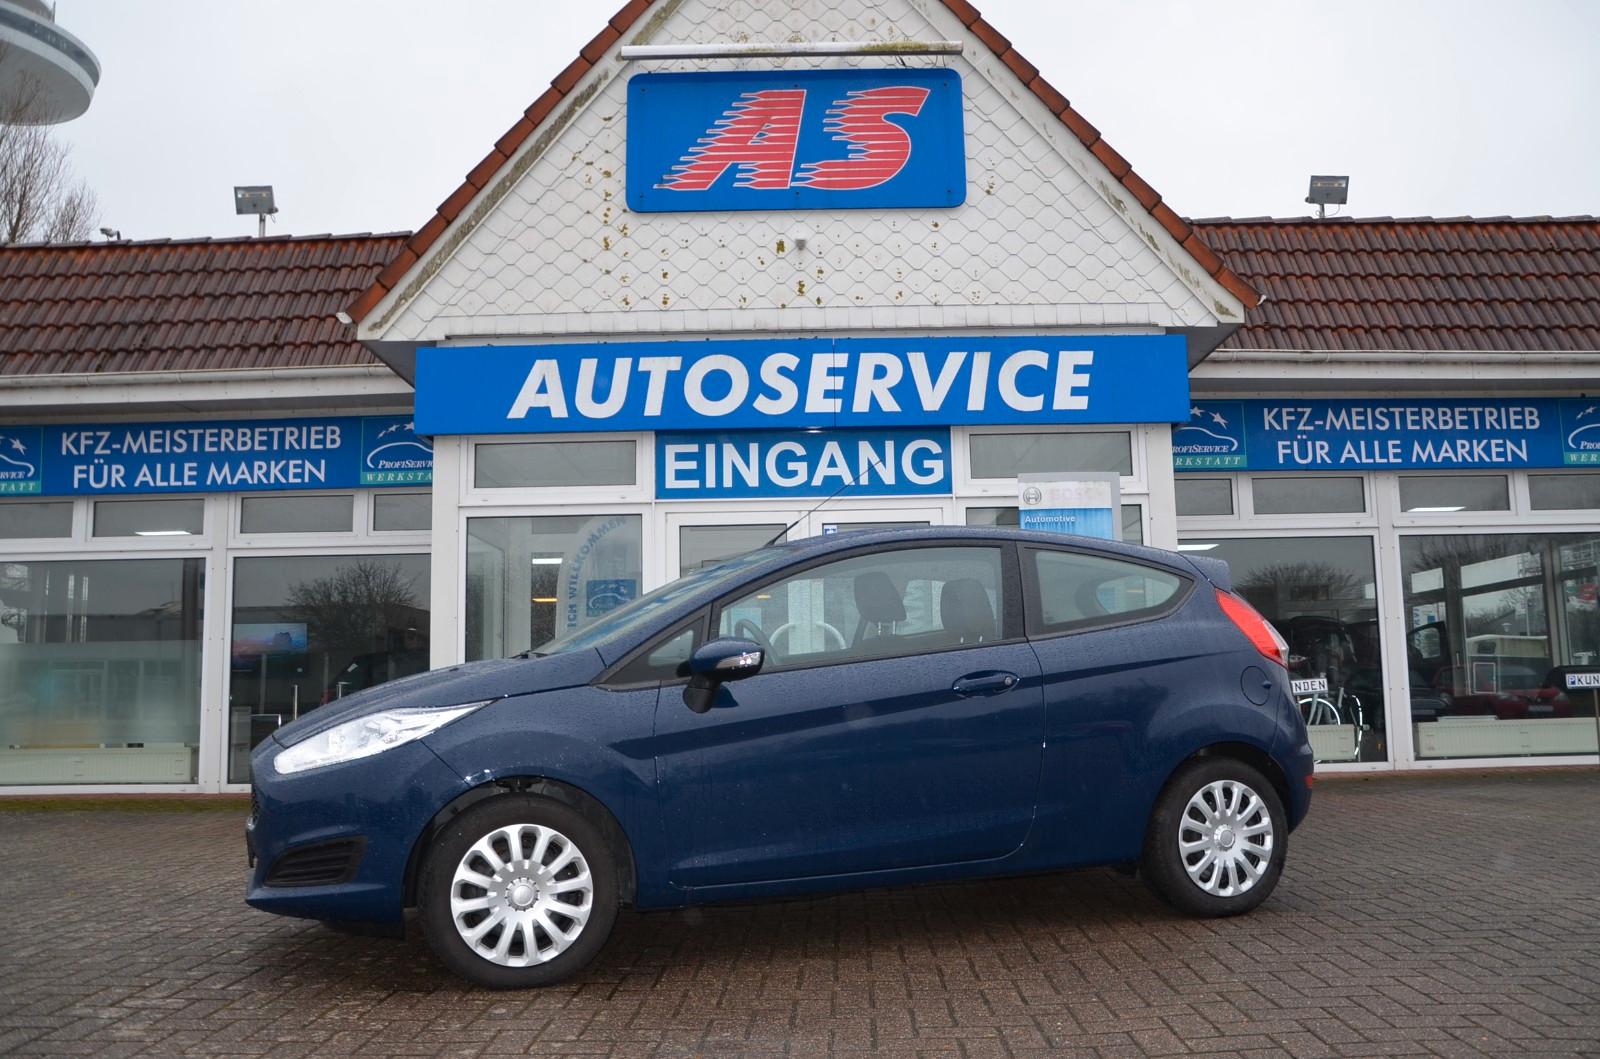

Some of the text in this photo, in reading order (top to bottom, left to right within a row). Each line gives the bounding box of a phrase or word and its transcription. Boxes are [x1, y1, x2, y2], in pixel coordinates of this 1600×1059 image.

[653, 86, 931, 191] AS
[507, 349, 1094, 421] AUTOSERVICE
[1263, 406, 1541, 431] KFZ-MEISTERBETRIEB
[61, 425, 341, 456] KFZ-MEISTERBETRIEB
[1277, 435, 1528, 464] FÜR ALLE MARKEN
[73, 459, 326, 489] FÜR ALLE MARKEN
[663, 439, 945, 489] EINGANG
[1024, 514, 1076, 524] Automotive
[568, 517, 625, 598] WILLKOMMEN
